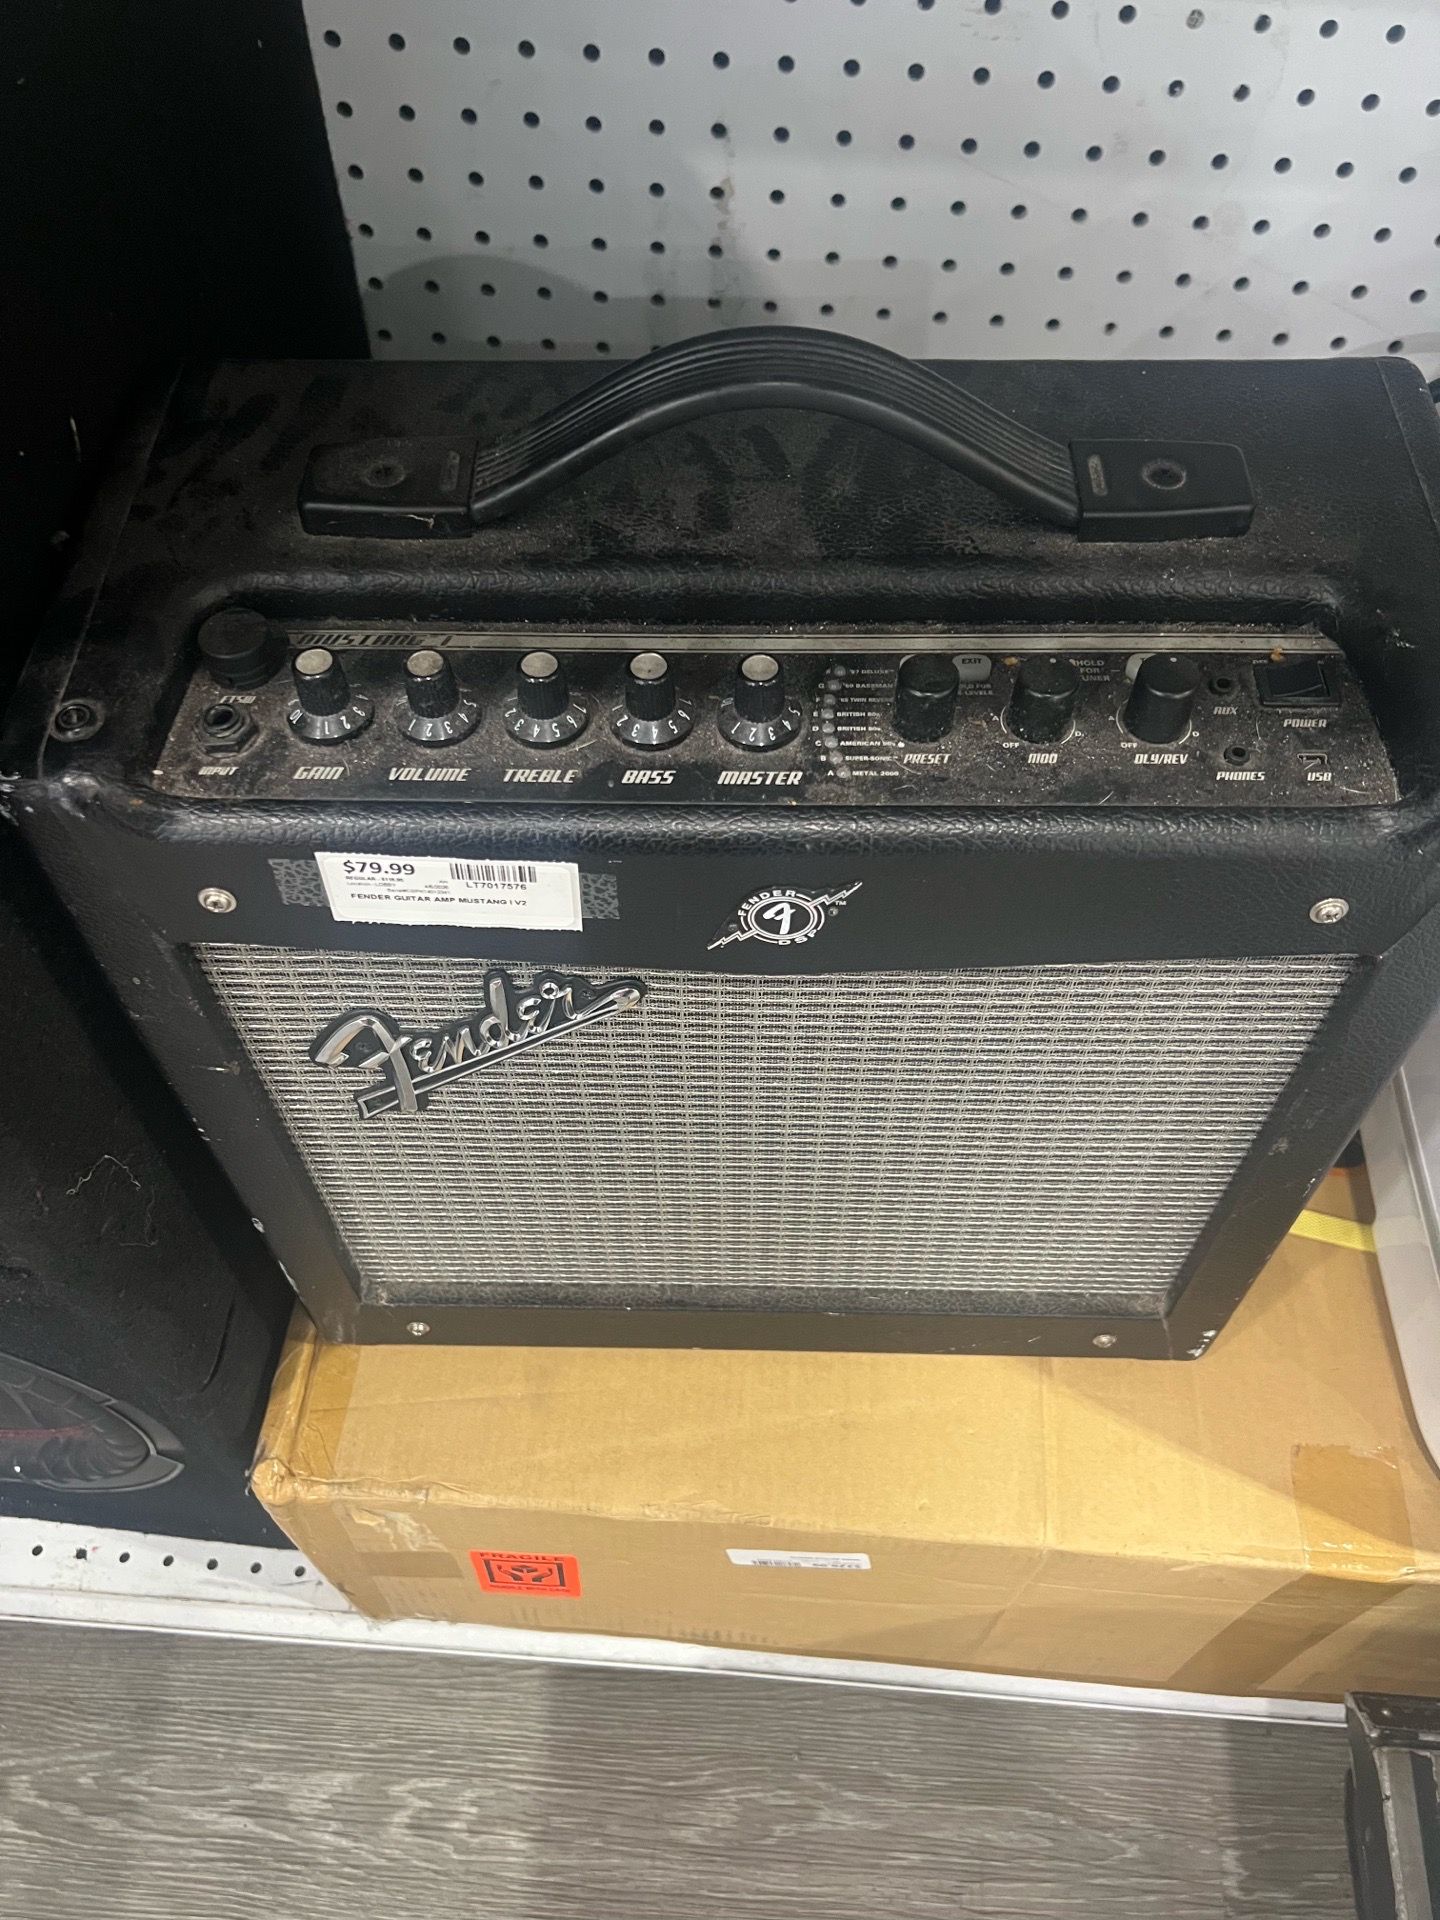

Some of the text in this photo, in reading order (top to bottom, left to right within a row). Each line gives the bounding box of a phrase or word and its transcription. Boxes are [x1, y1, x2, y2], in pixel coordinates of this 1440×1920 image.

[297, 633, 429, 647] MUSTANG
[1213, 706, 1238, 715] AUX
[1283, 718, 1327, 728] POWER
[903, 753, 952, 765] PRESET
[1027, 753, 1058, 764] MOD
[1134, 753, 1190, 765] DLY/REV
[198, 766, 240, 776] INPUT
[292, 766, 346, 780] GAIN
[388, 767, 472, 782] VOLUME
[502, 768, 579, 784] TREBLE
[621, 770, 677, 785] BASS
[1216, 771, 1266, 781] PHONES
[1307, 772, 1332, 782] USB
[716, 770, 804, 786] MASTER
[343, 860, 416, 875] $79.99
[466, 882, 528, 890] LT7017576
[738, 889, 798, 917] FENDER
[778, 928, 818, 946] DSP
[313, 975, 645, 1120] Fender
[480, 1552, 565, 1562] FRAGILE
